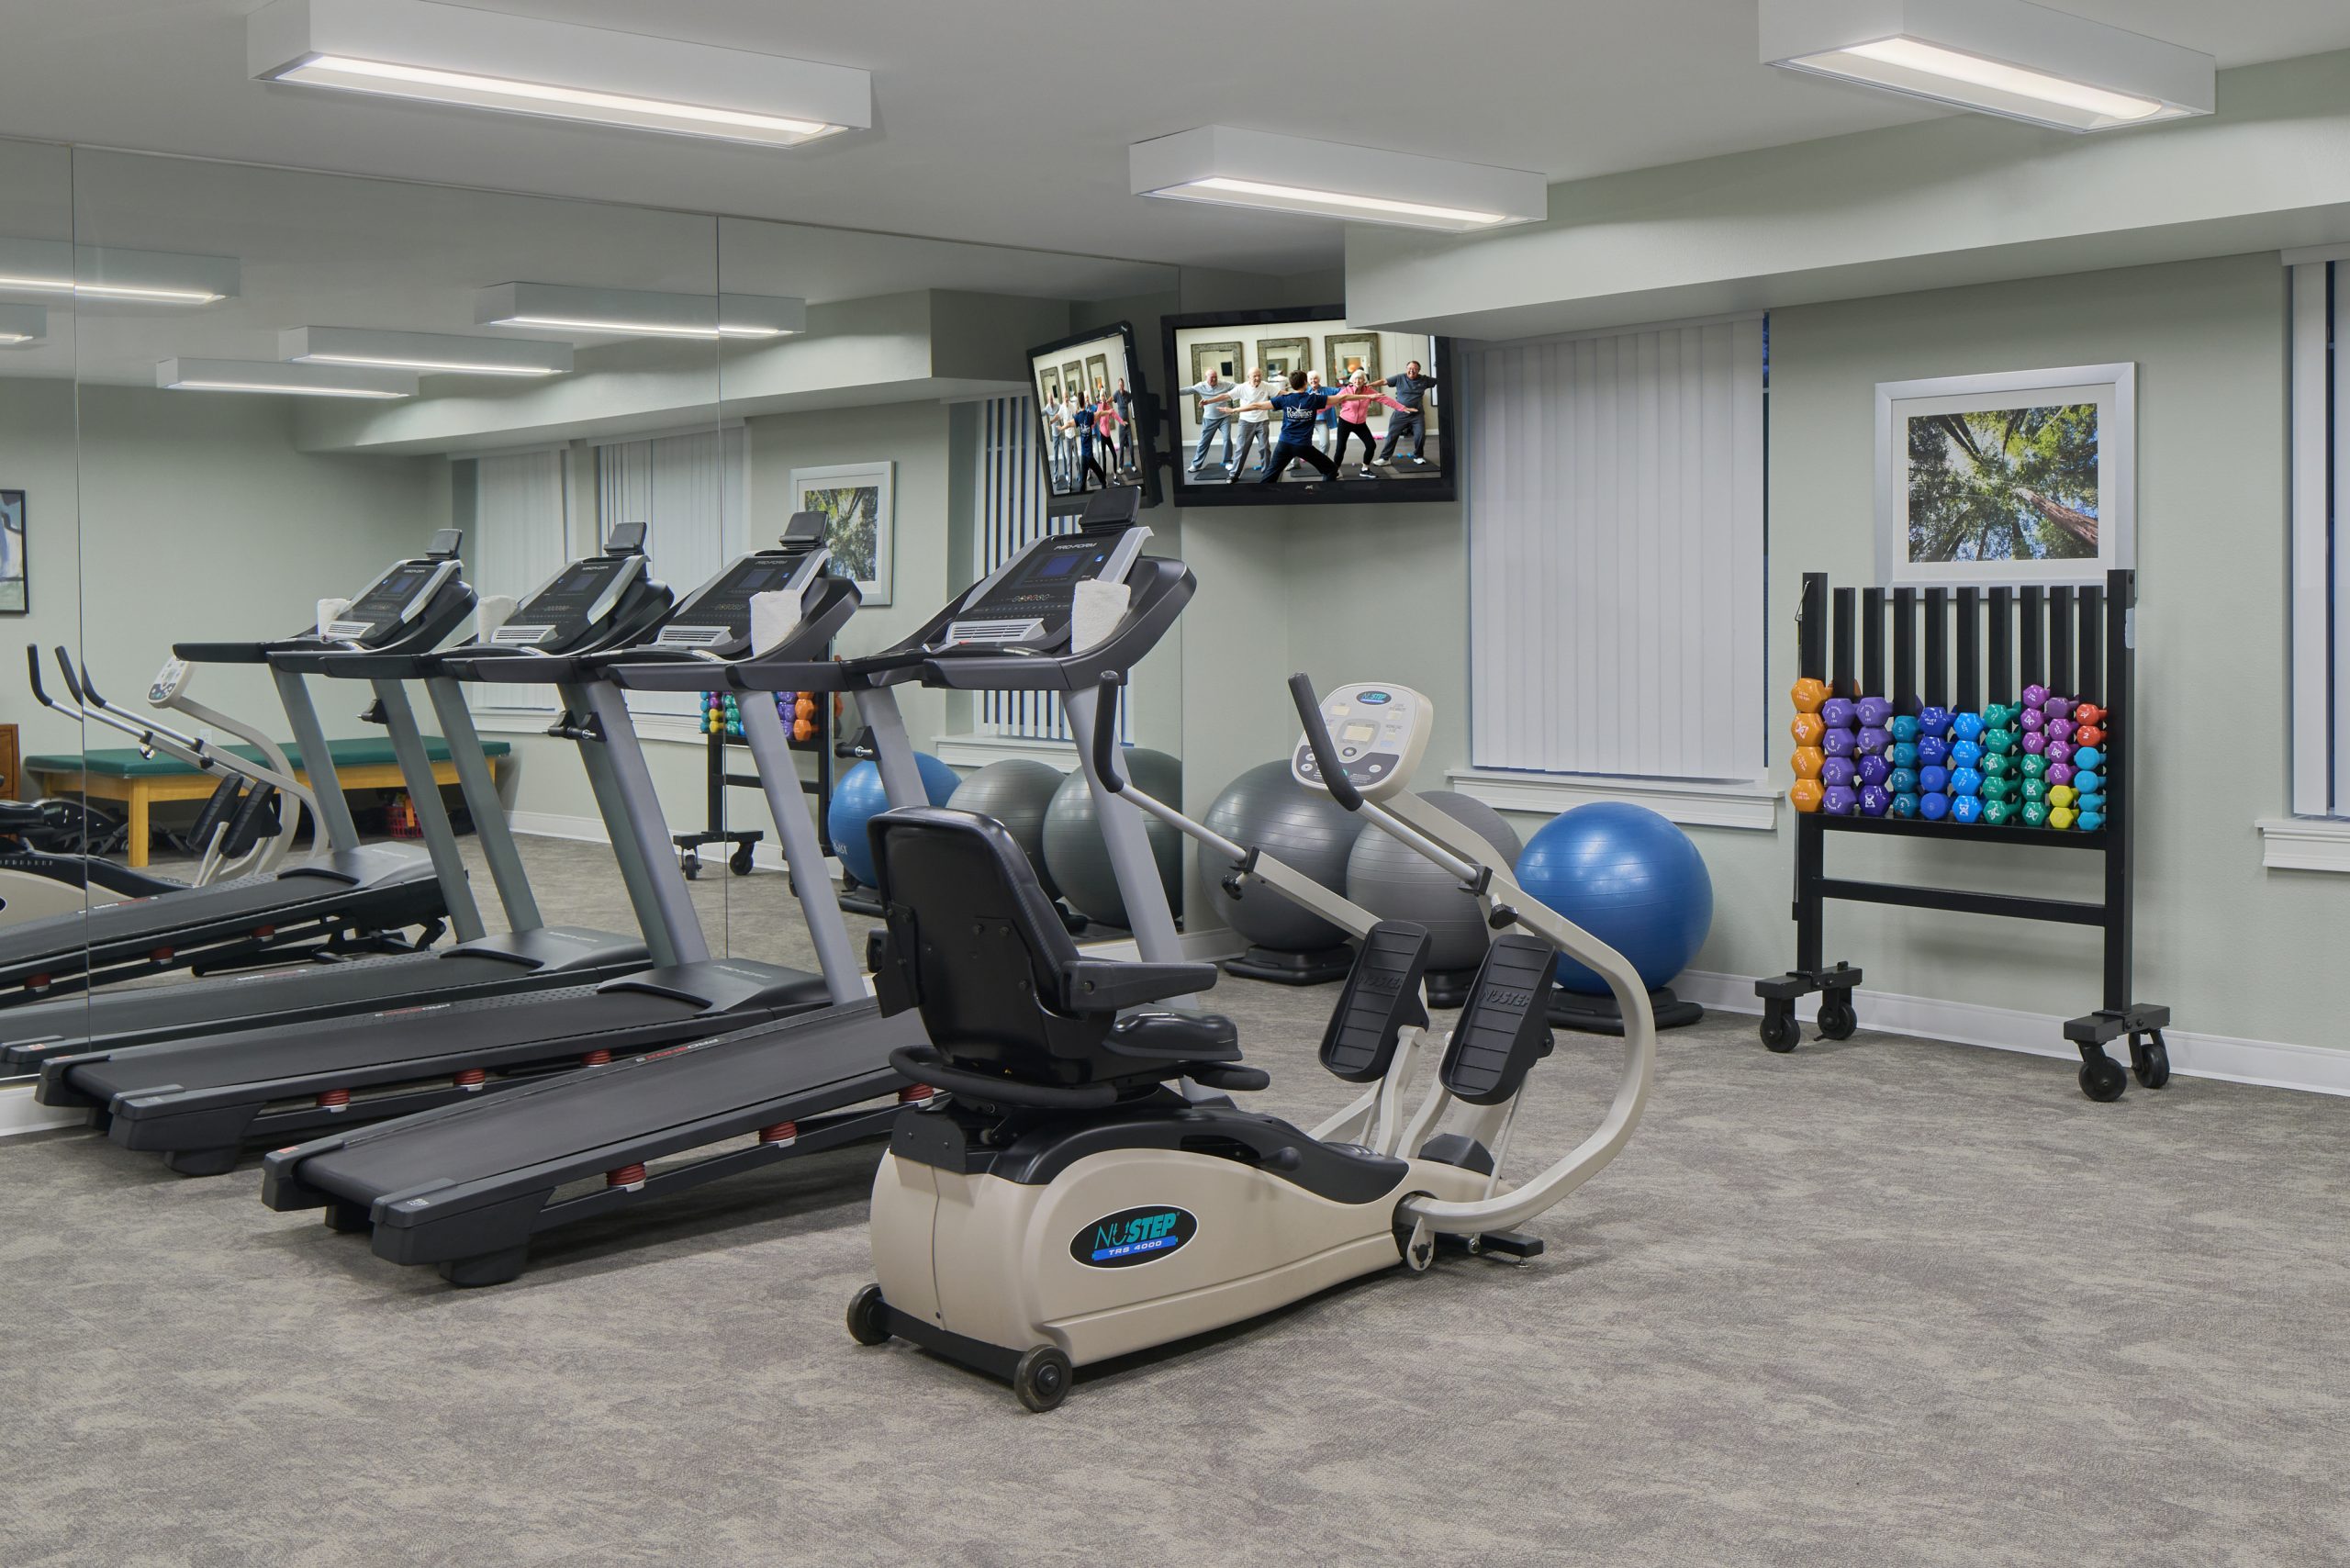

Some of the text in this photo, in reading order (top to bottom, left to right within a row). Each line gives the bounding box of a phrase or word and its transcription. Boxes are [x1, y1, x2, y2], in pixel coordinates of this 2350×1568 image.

[1094, 1212, 1177, 1249] NUSTEP
[1108, 1240, 1162, 1256] TRS 4000
